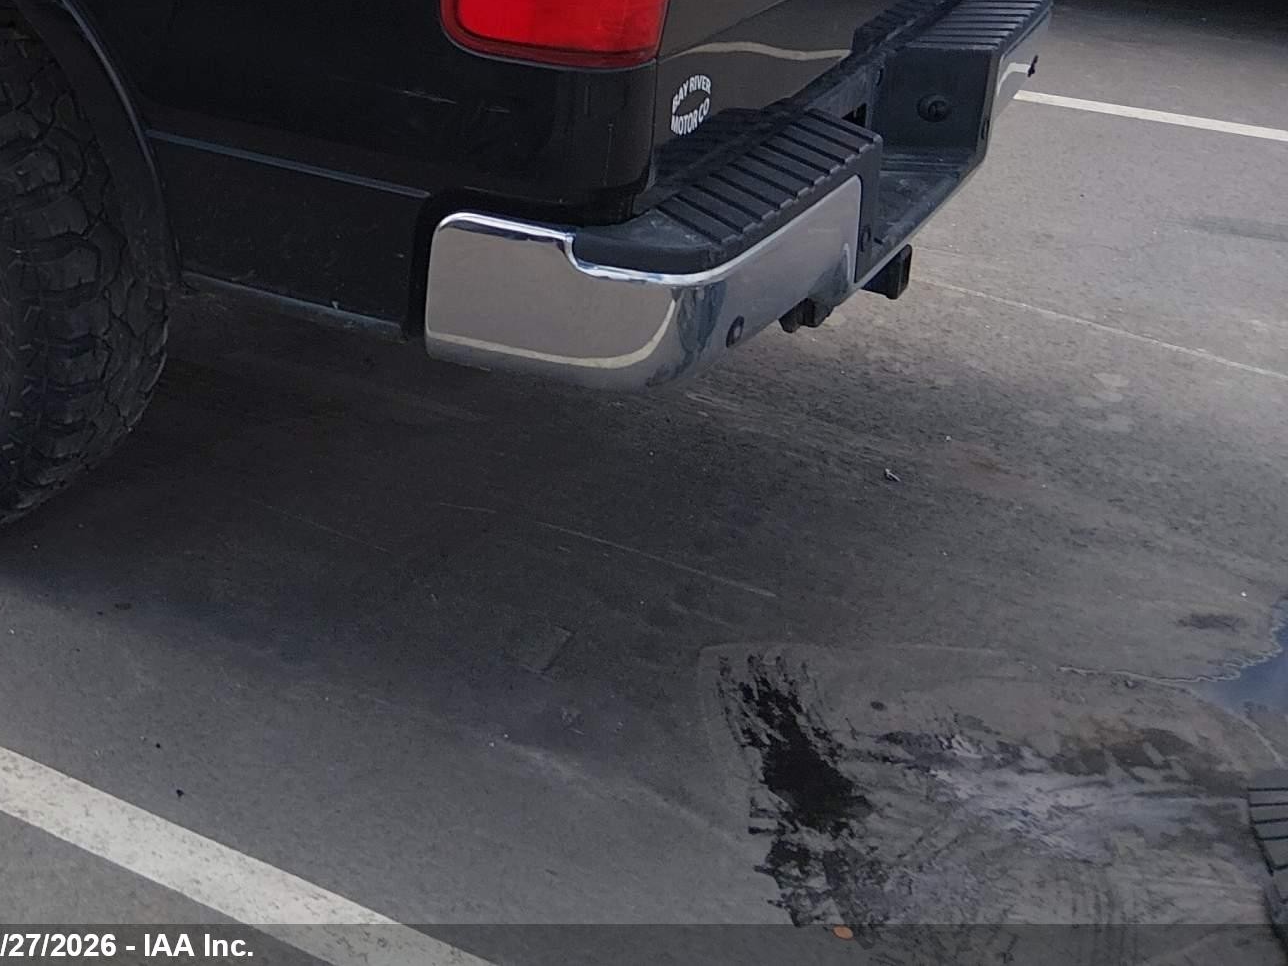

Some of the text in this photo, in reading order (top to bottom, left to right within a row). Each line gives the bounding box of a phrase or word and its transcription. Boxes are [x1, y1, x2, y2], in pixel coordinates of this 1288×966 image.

[672, 75, 711, 114] BAY RIVER
[671, 97, 709, 135] MOTOR CO
